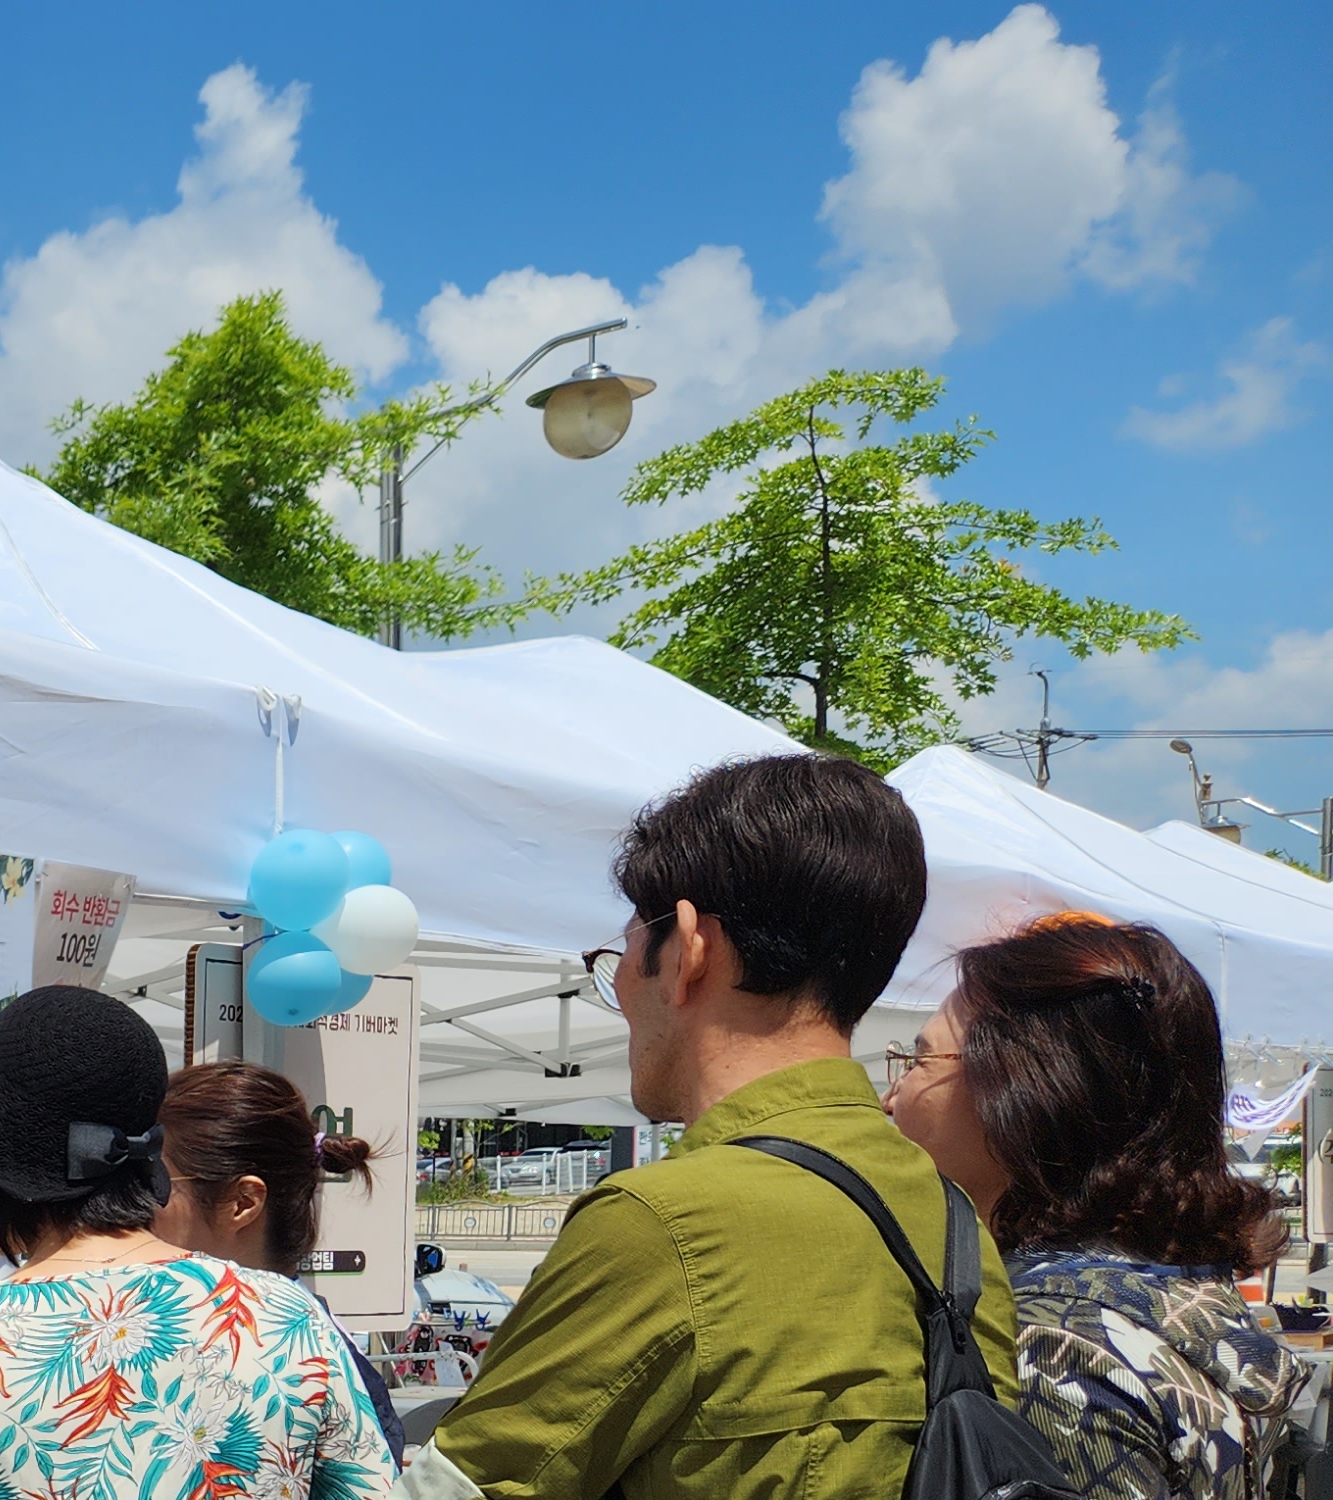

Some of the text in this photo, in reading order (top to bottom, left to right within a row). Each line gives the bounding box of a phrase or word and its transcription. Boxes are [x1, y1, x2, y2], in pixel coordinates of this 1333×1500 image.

[51, 890, 120, 928] 회수 반환금
[56, 932, 101, 967] 100원
[219, 1004, 243, 1022] 202
[355, 1015, 399, 1035] 기버마켓
